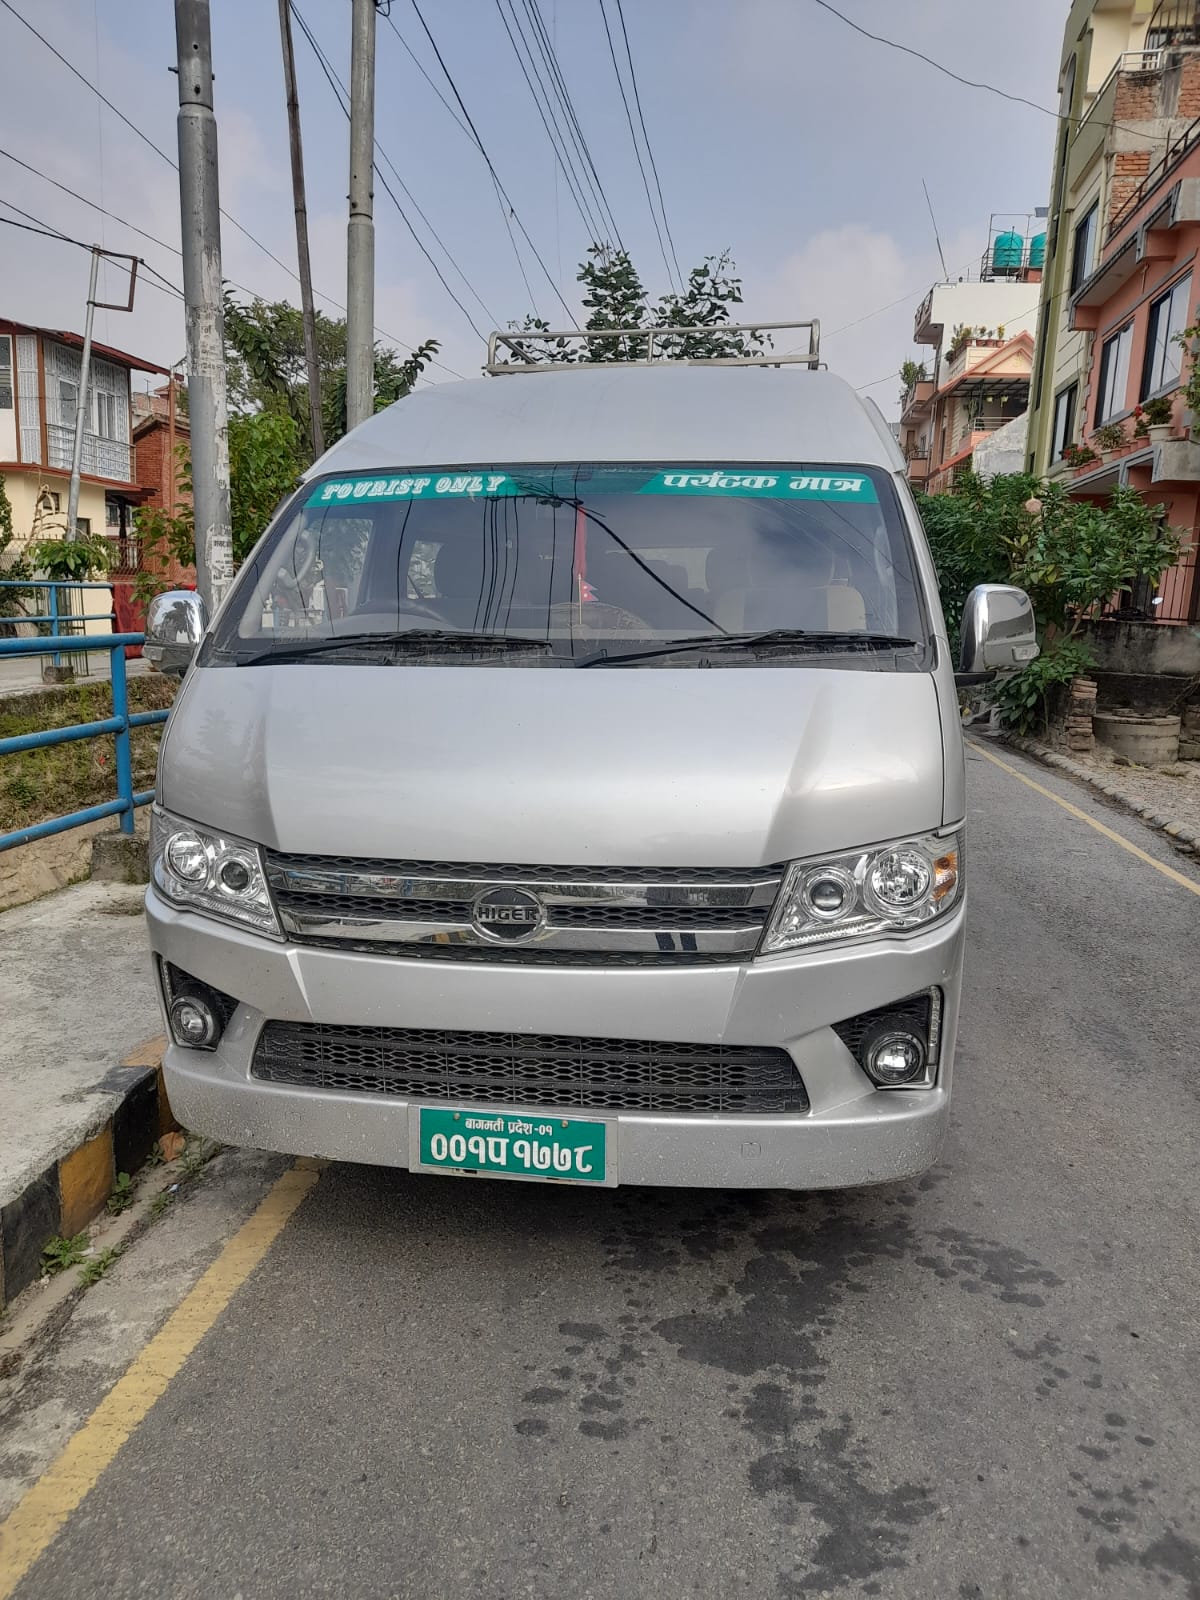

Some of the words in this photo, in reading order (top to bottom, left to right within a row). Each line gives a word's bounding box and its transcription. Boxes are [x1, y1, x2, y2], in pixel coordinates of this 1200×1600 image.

[320, 477, 430, 500] TOURIST
[435, 475, 506, 493] ONLY
[789, 476, 865, 492] मात्र
[478, 906, 538, 921] HIGER
[465, 1117, 504, 1132] बागमती
